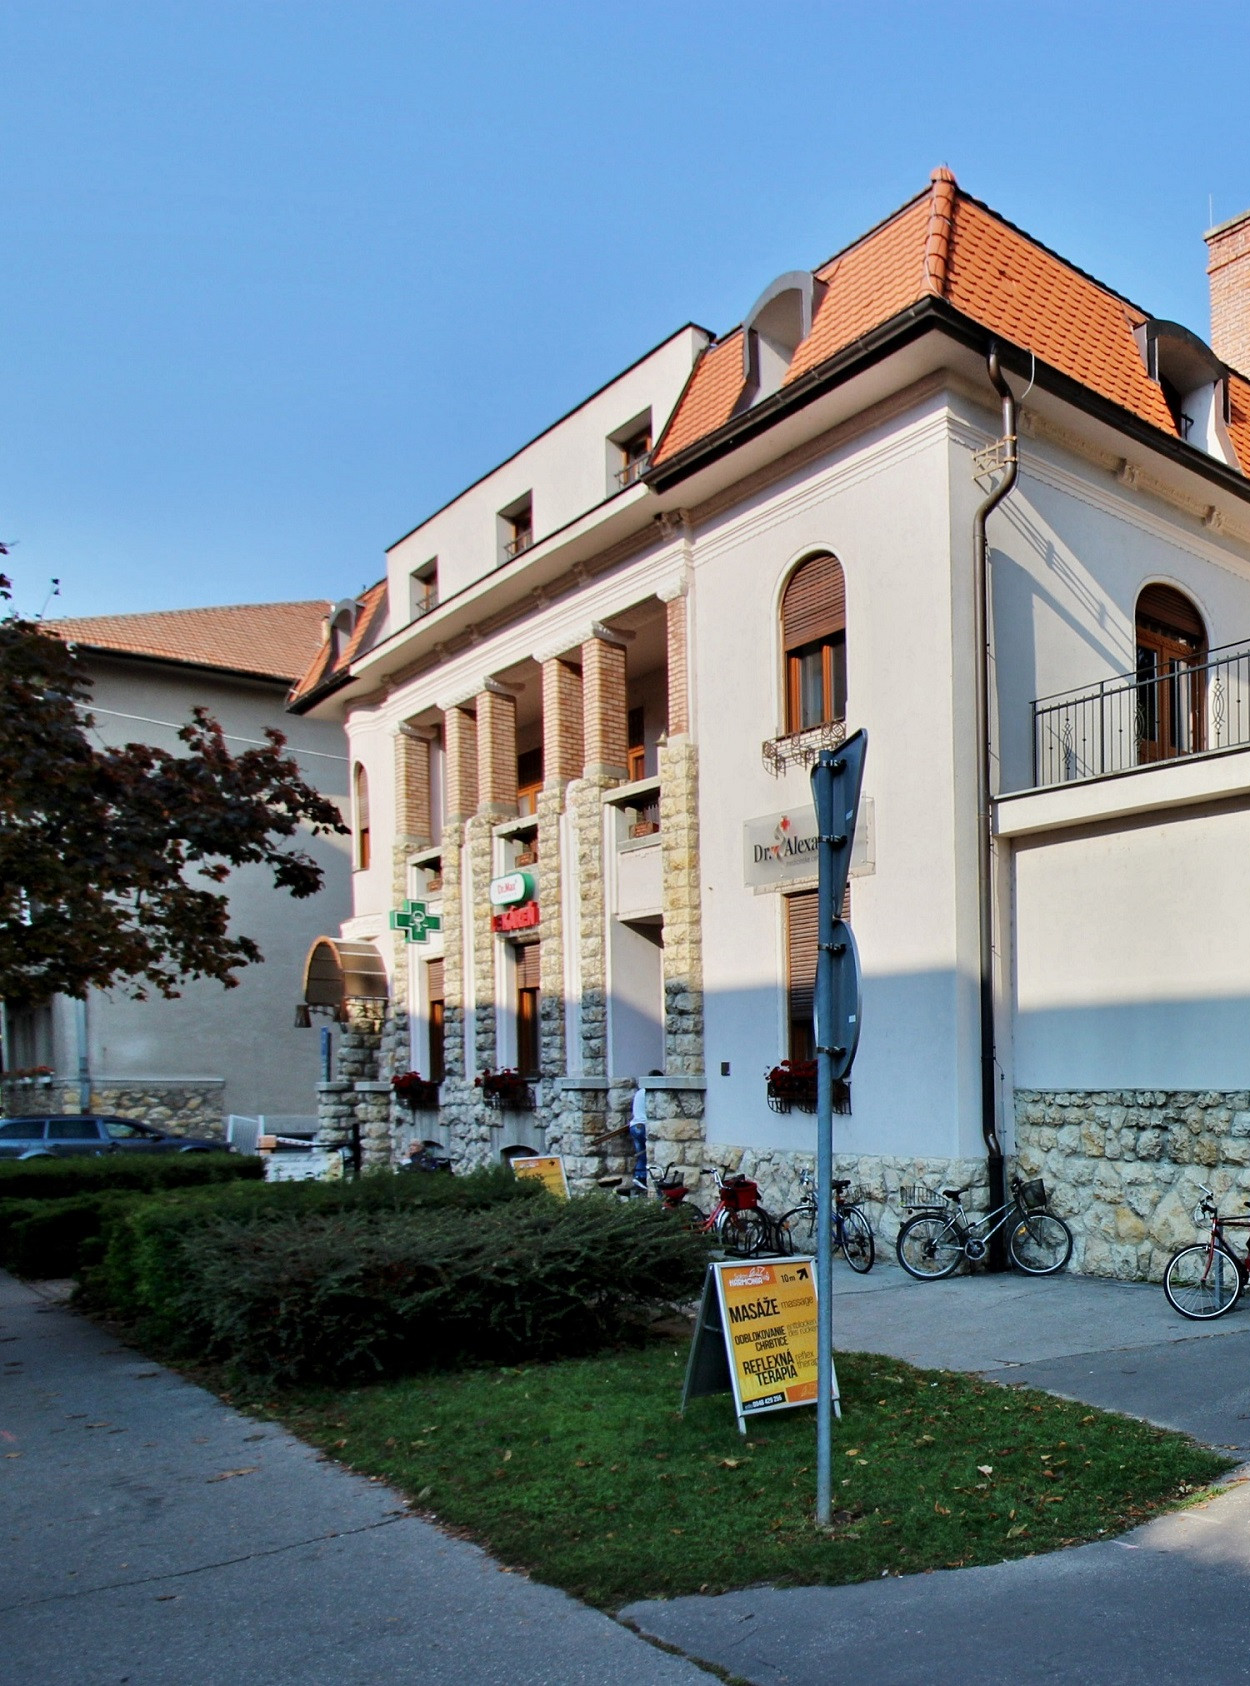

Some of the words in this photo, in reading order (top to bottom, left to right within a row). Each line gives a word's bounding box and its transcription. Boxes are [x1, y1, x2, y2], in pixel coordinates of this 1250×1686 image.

[753, 844, 772, 863] Dr.
[784, 835, 820, 857] Alexa
[728, 1297, 781, 1323] MASÁŽE
[780, 1296, 814, 1309] massage
[734, 1325, 786, 1346] ODBLOKOVANIE
[754, 1335, 789, 1352] CHRBTICE
[742, 1348, 795, 1375] REFLEXNÁ
[755, 1365, 798, 1386] TERAPIA
